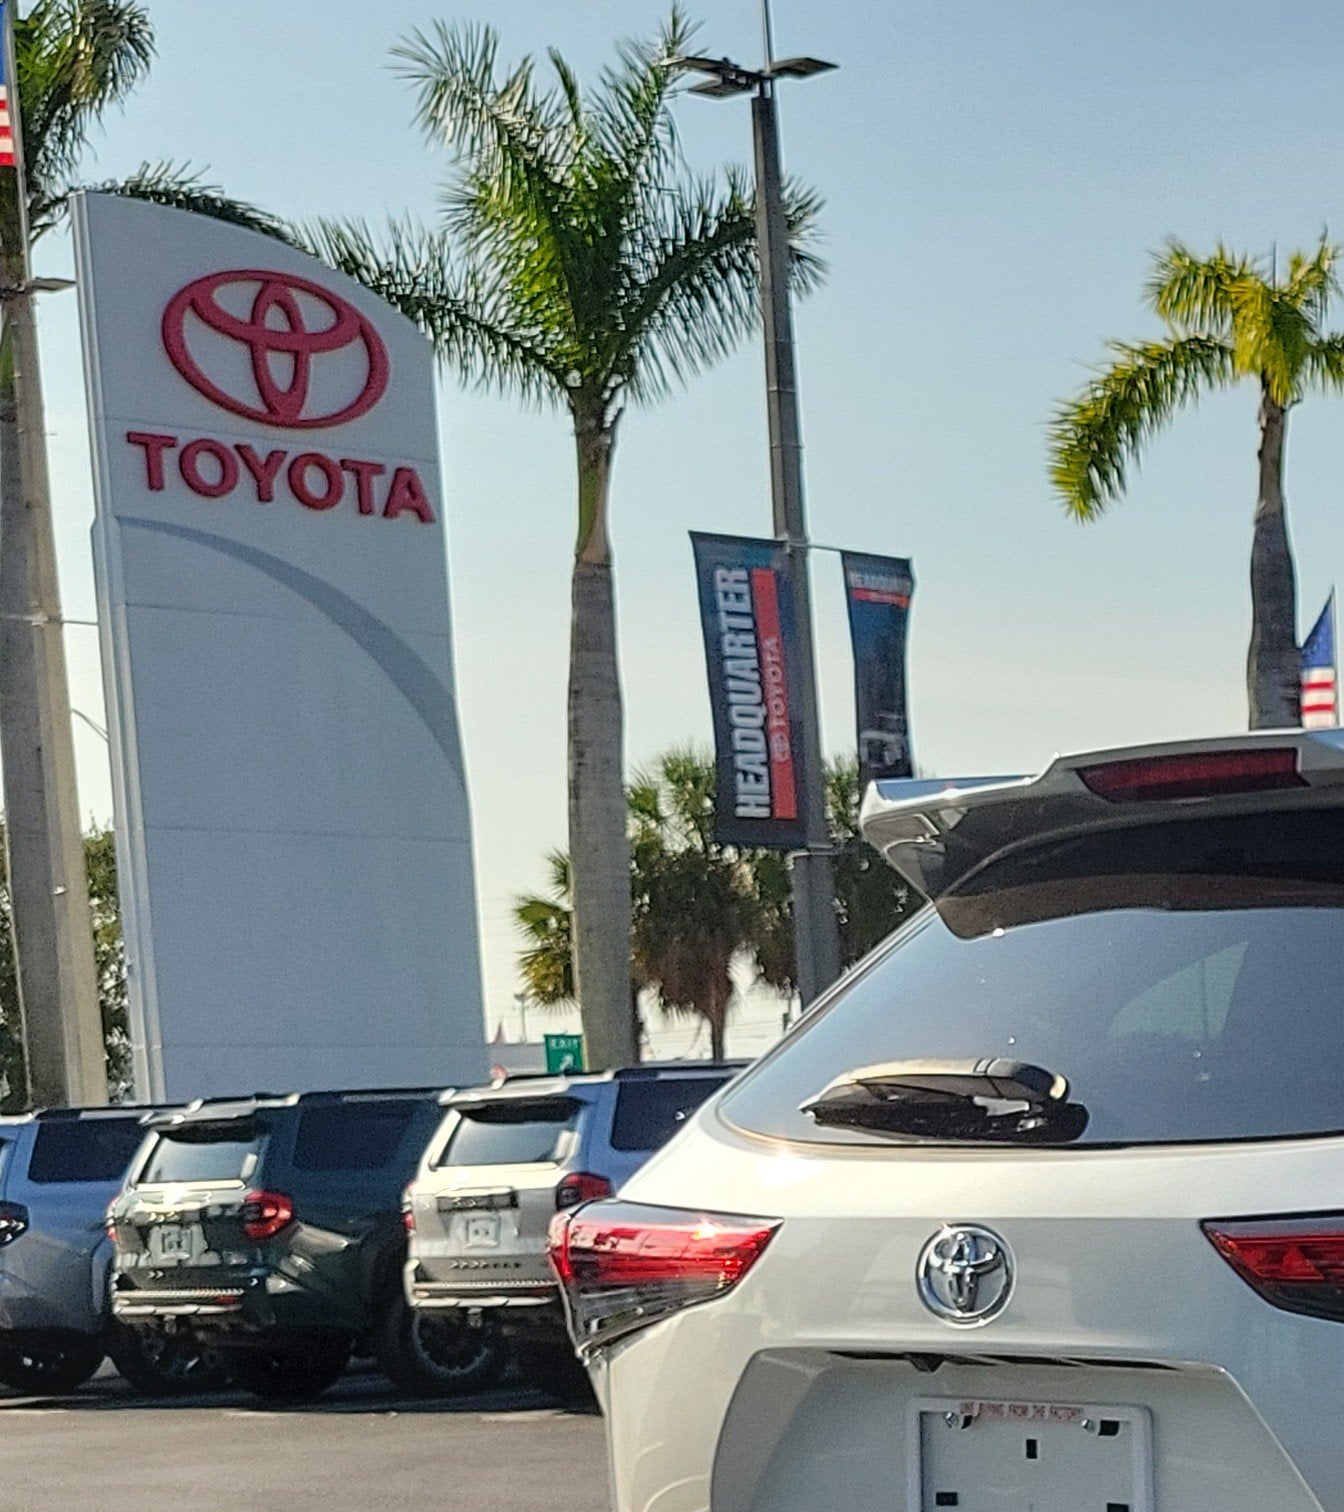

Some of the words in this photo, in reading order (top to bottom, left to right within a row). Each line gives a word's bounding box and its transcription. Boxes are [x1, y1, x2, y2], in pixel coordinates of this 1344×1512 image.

[126, 431, 436, 524] TOYOTA
[715, 567, 771, 818] HEADQUARTER
[763, 636, 787, 728] TOYOTA
